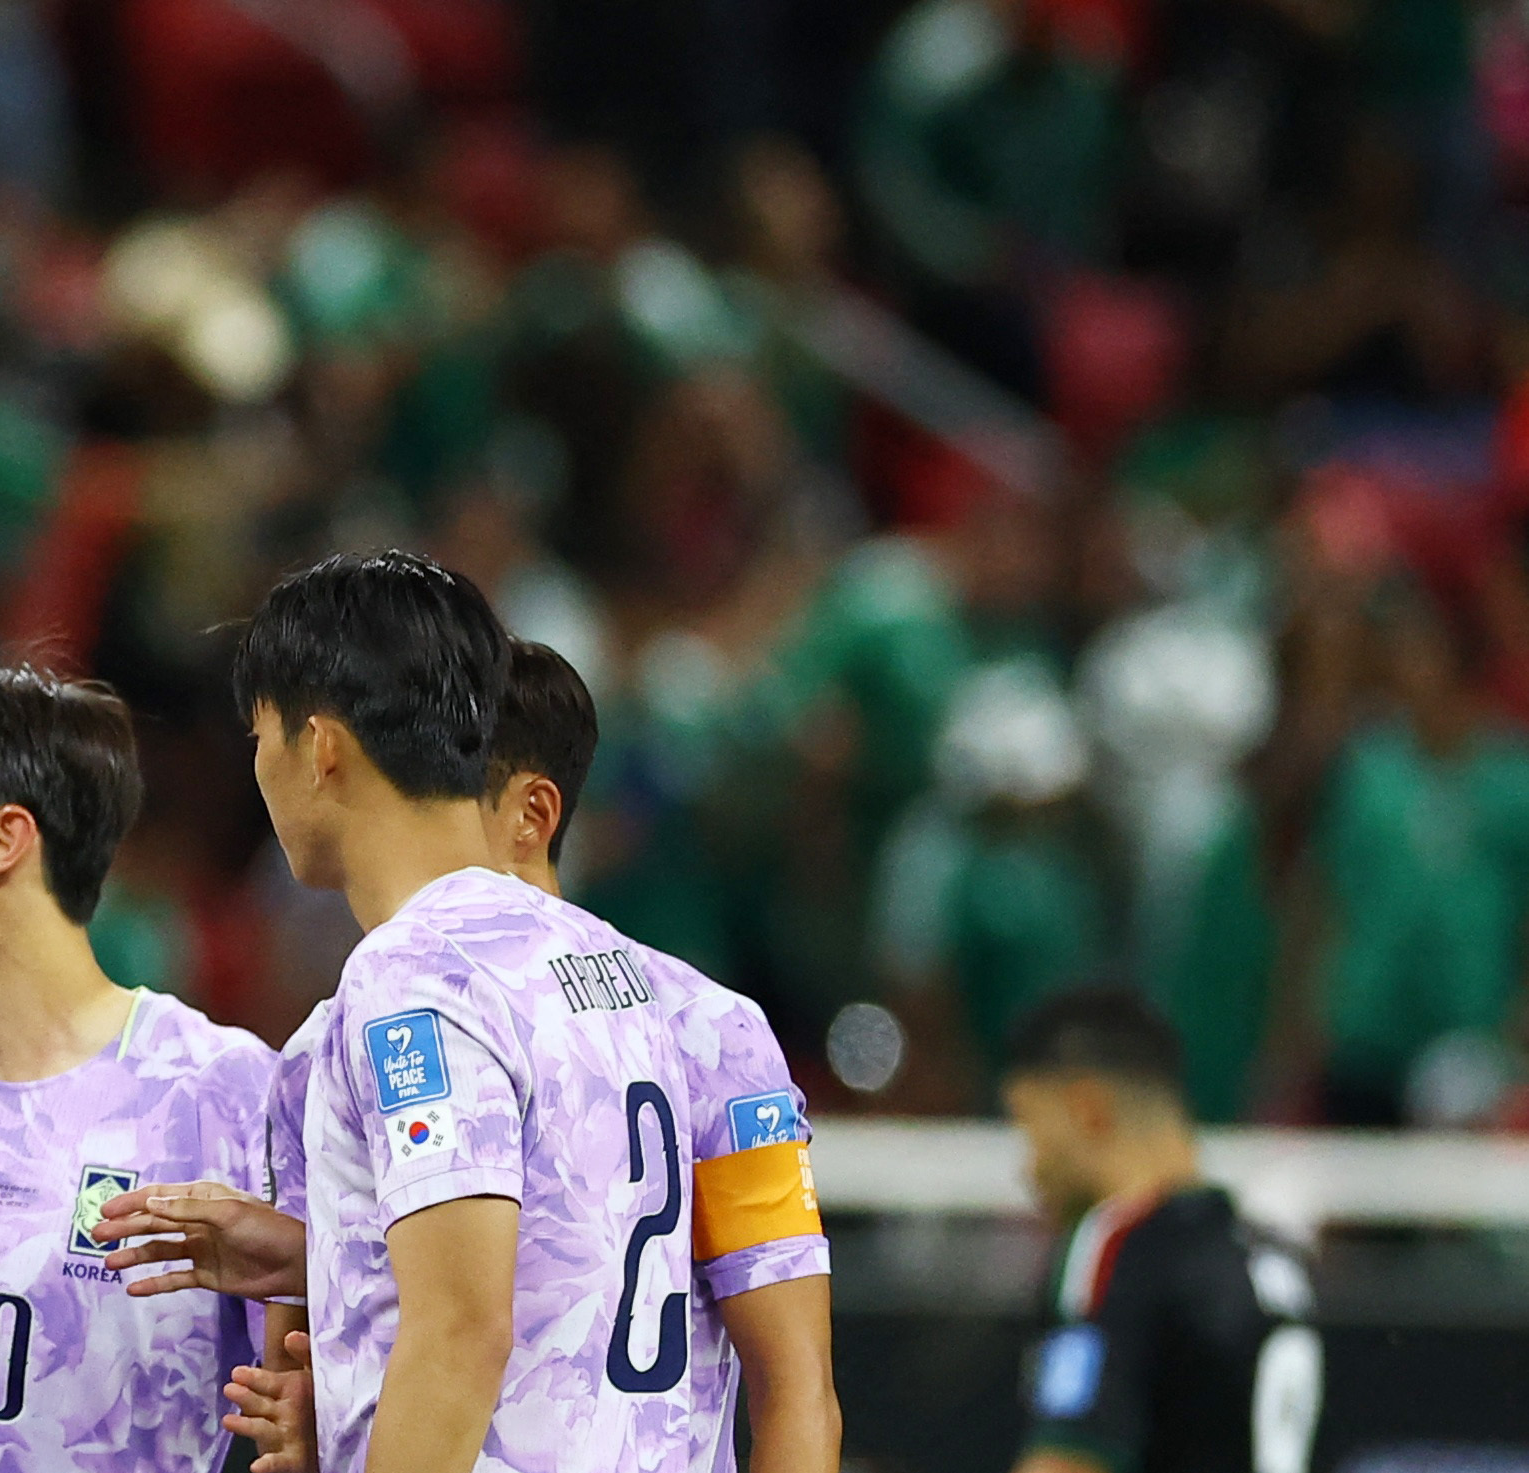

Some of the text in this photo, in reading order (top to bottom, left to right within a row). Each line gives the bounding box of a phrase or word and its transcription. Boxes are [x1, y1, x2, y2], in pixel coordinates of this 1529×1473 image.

[388, 1066, 427, 1091] PEACE
[398, 1085, 421, 1099] FIFA
[605, 1080, 689, 1394] 2
[61, 1262, 123, 1285] KOREA
